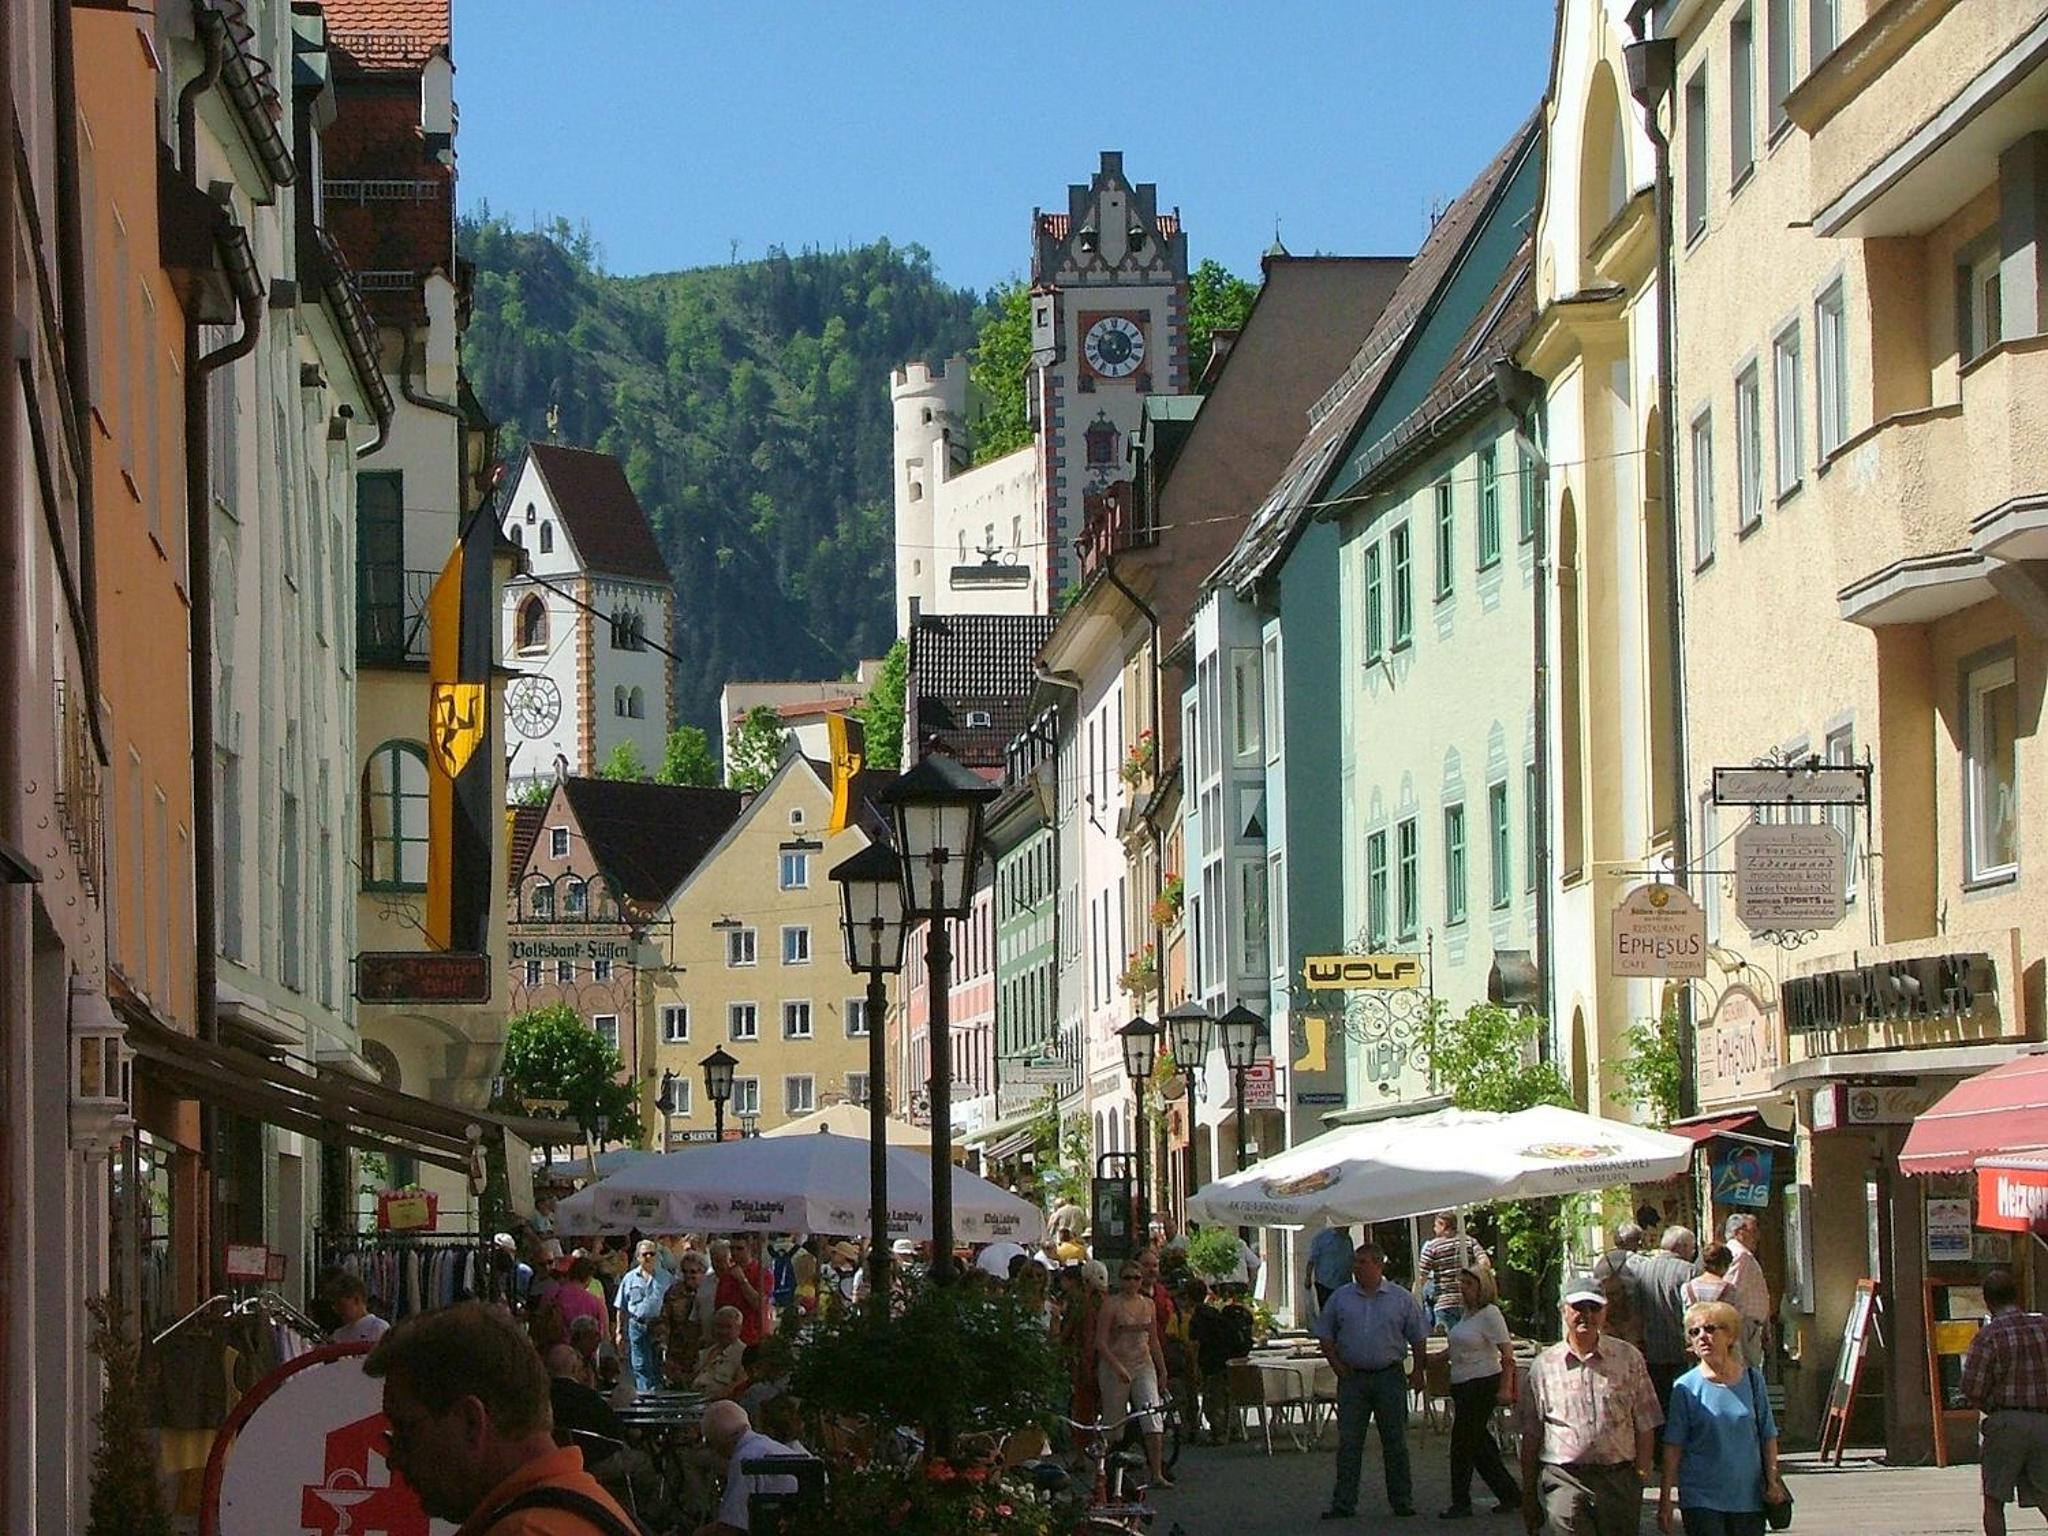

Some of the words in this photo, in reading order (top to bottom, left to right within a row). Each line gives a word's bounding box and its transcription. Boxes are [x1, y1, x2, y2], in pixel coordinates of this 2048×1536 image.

[1618, 932, 1700, 960] EPHESUS
[1309, 961, 1415, 982] WOLF
[1734, 1184, 1770, 1201] EIS
